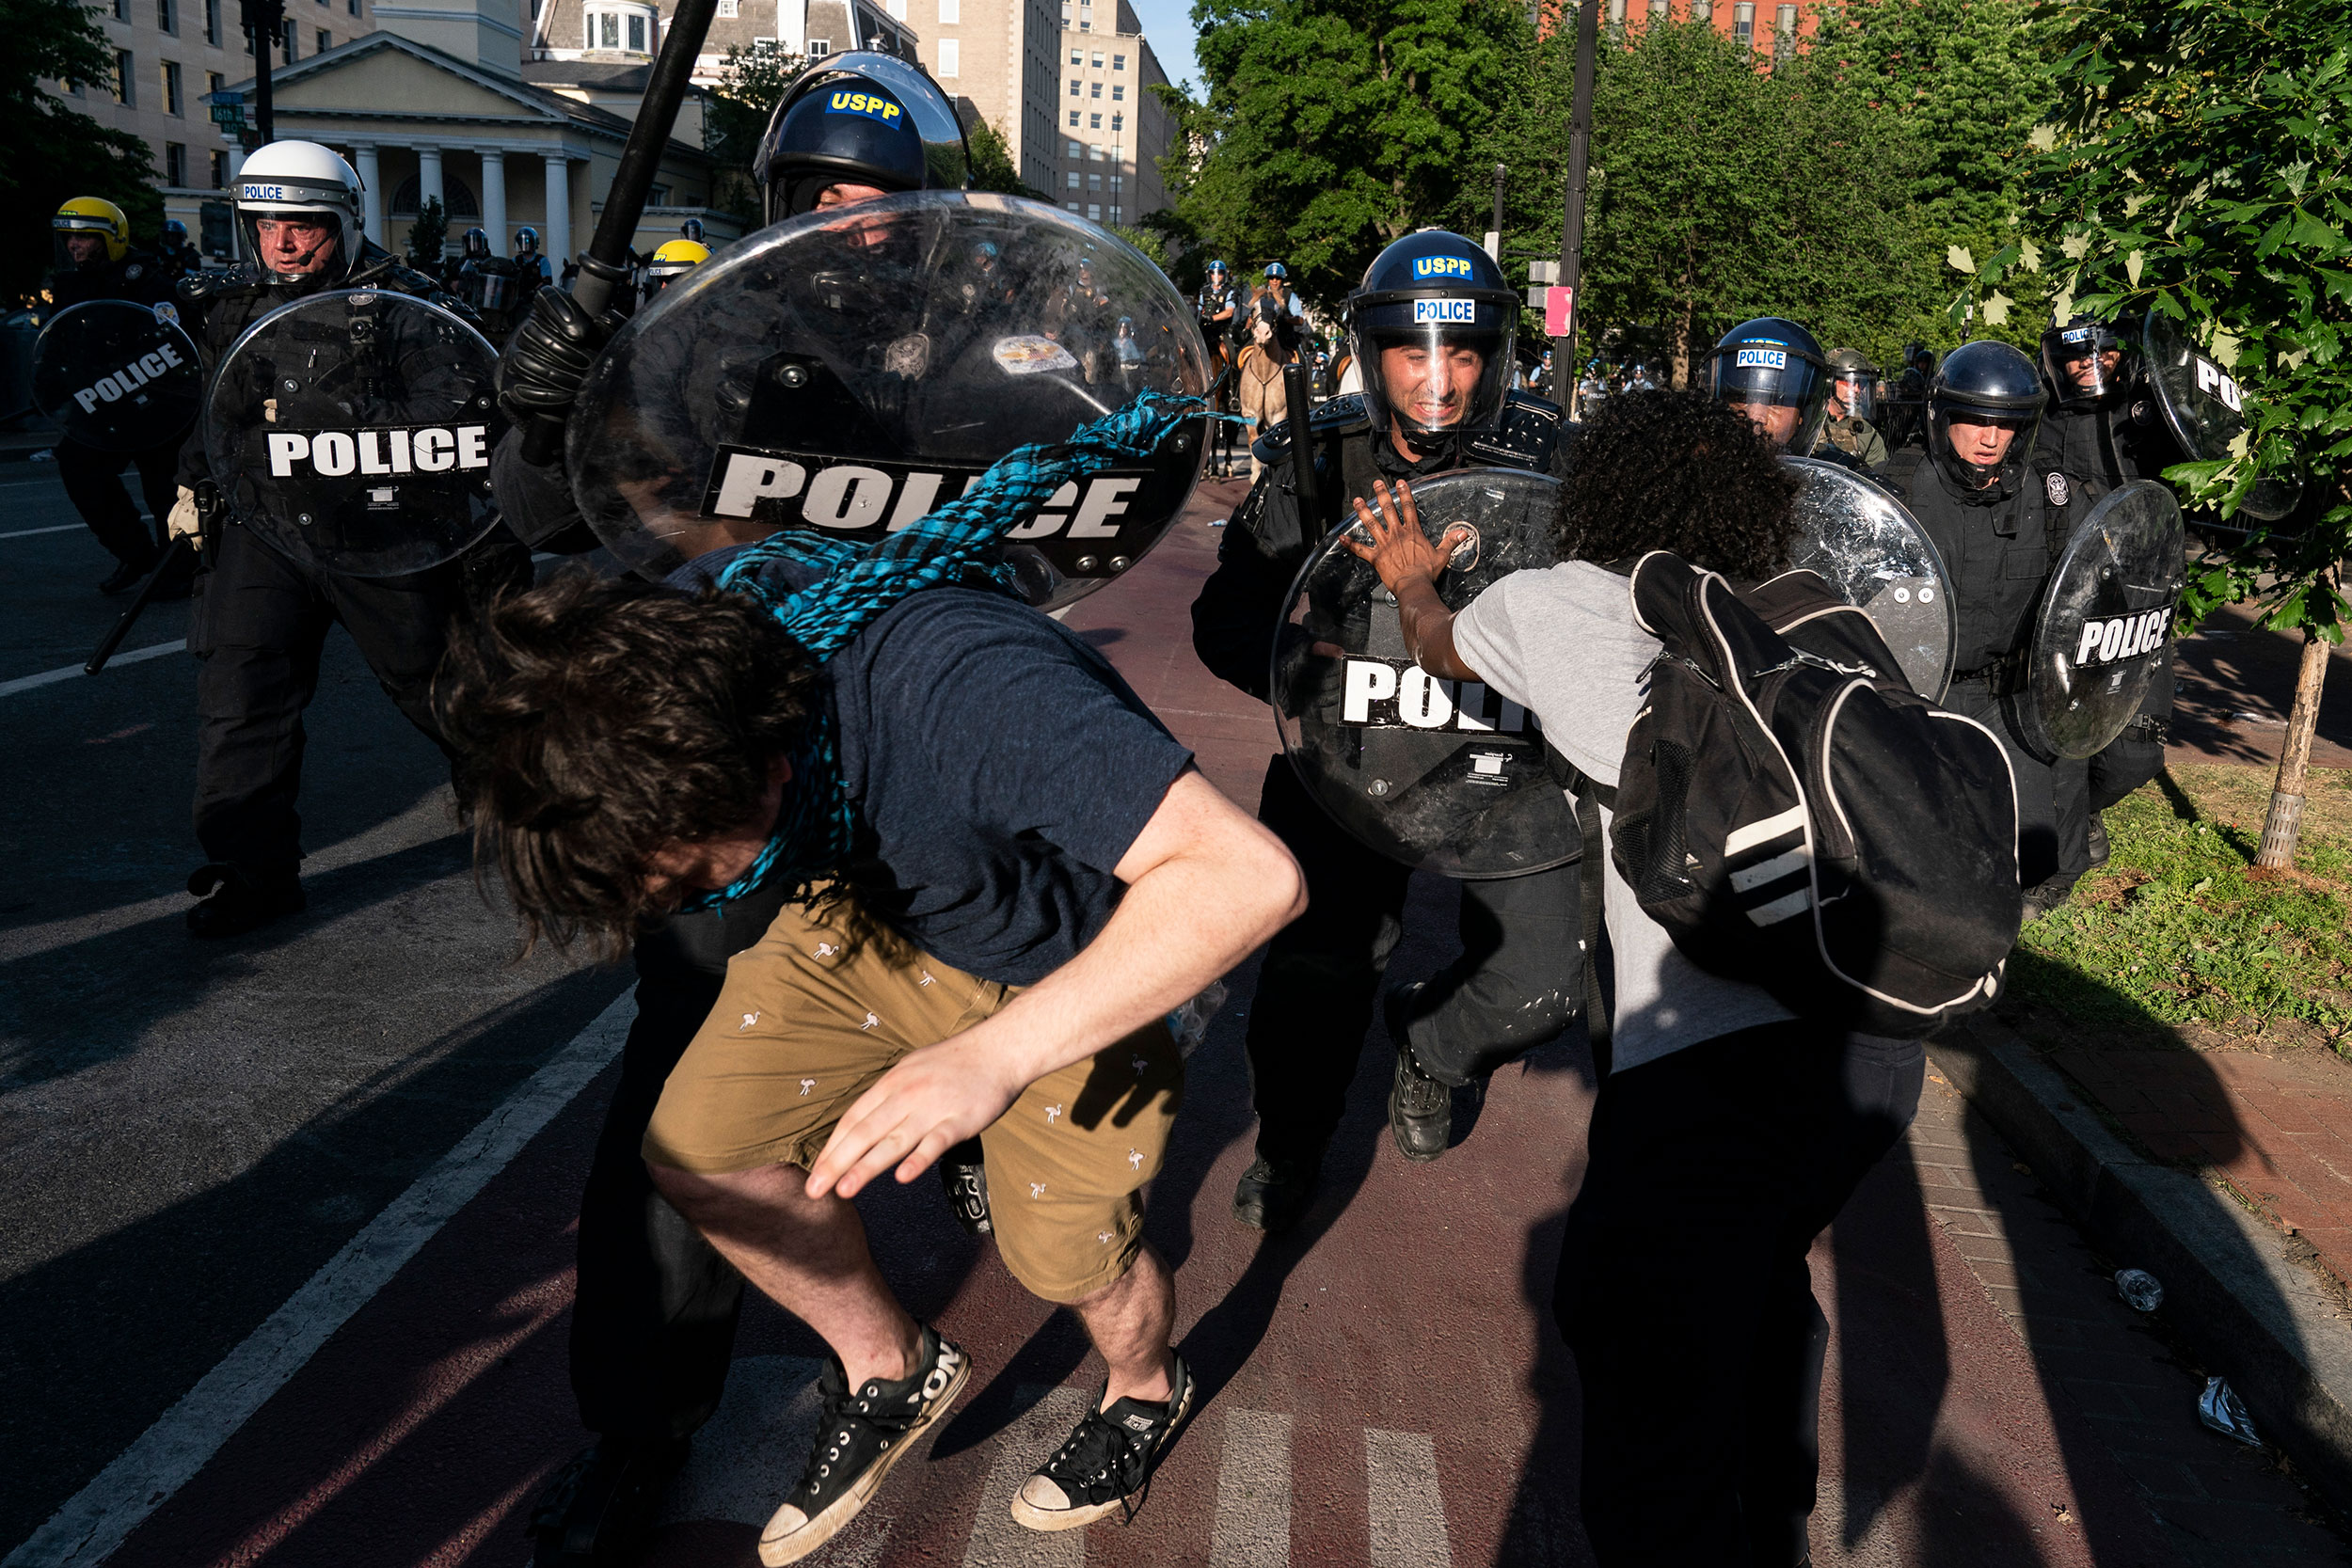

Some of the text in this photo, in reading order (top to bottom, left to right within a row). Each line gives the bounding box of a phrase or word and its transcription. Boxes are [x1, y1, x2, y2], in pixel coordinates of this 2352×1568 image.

[215, 107, 233, 120] 16th
[831, 93, 900, 119] USPP
[245, 185, 282, 198] POLICE
[1417, 257, 1471, 276] USPP
[1417, 302, 1472, 320] POLICE
[1739, 350, 1784, 366] POLICE
[73, 342, 183, 414] POLICE
[2196, 357, 2250, 412] PO
[267, 425, 488, 477] POLICE
[714, 453, 1141, 539] POLCE
[2075, 608, 2171, 664] POLICE
[1343, 660, 1544, 732] POLI
